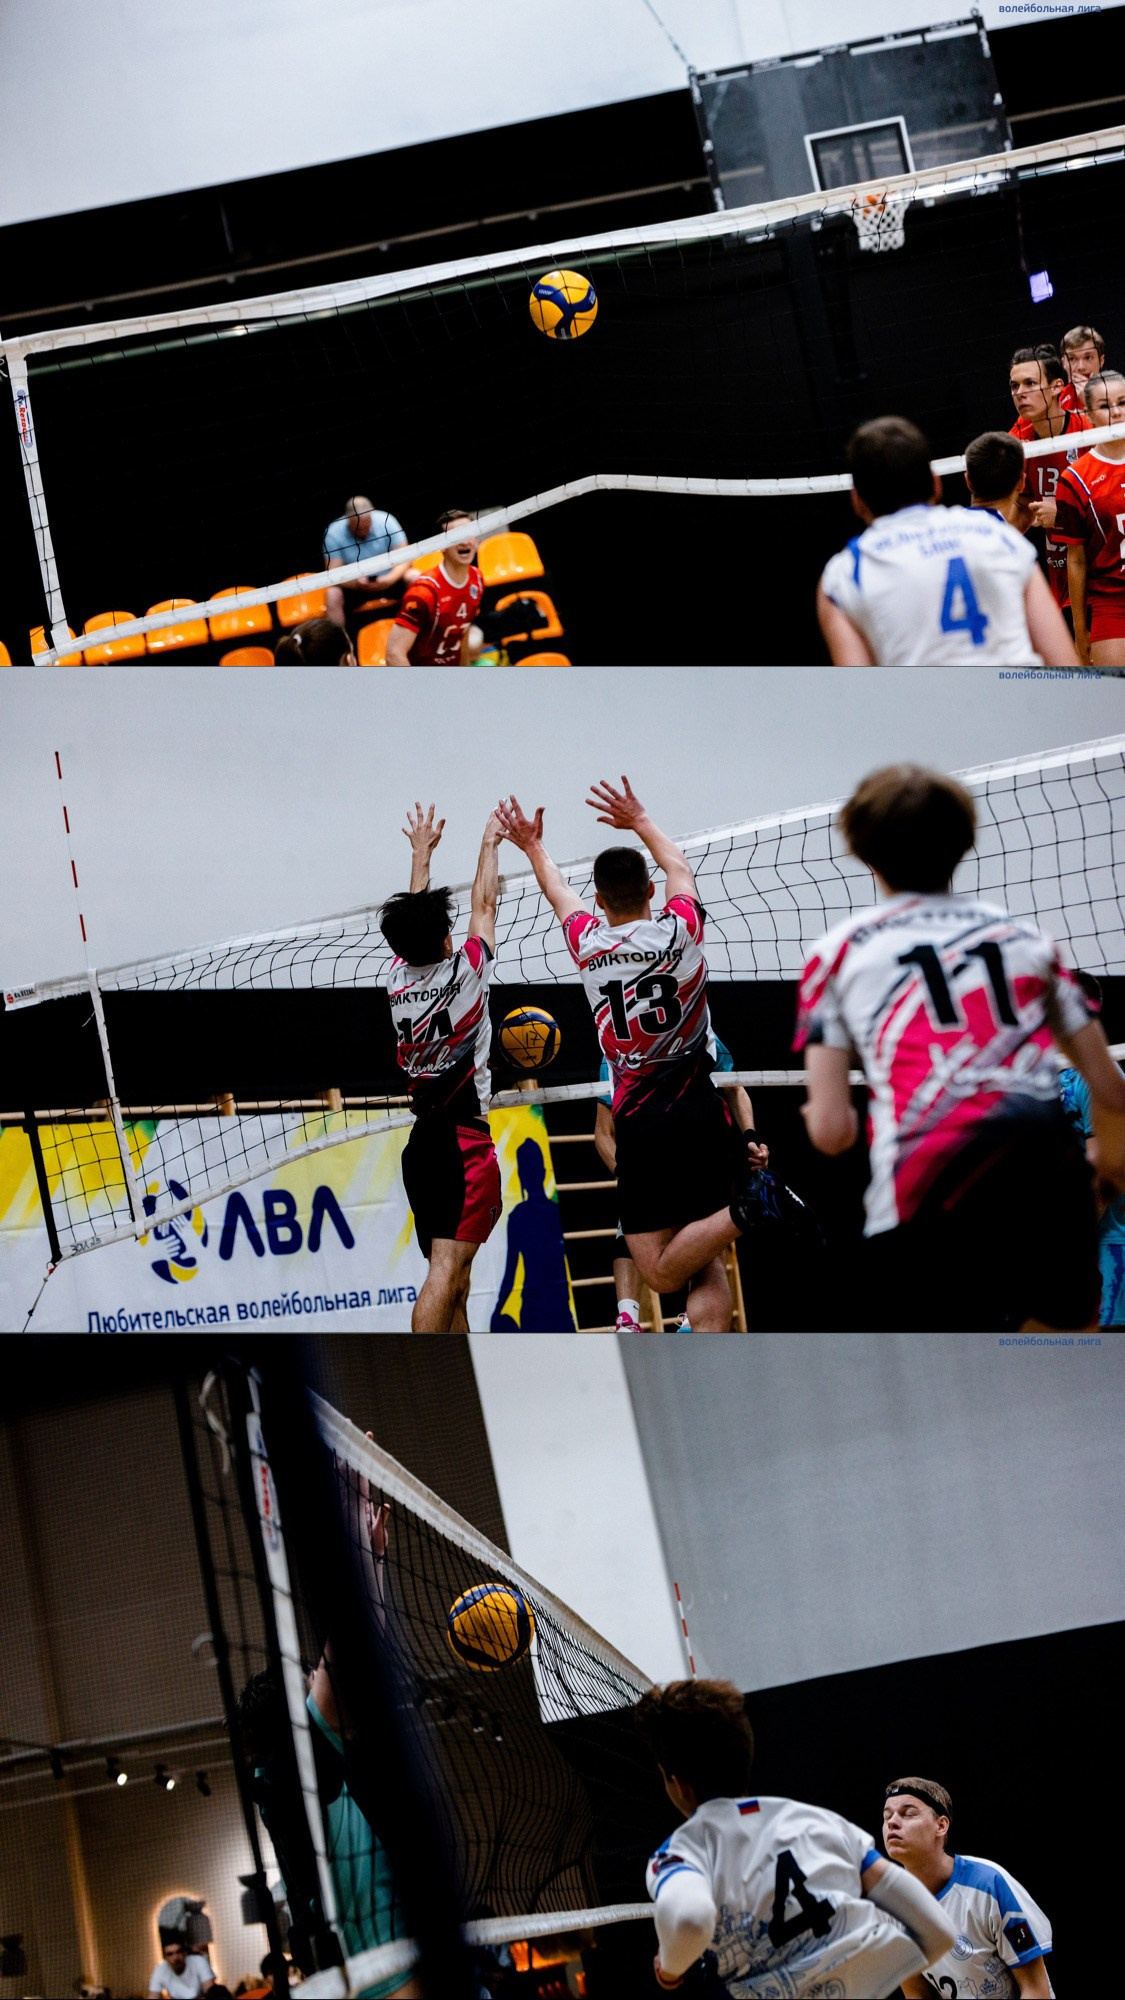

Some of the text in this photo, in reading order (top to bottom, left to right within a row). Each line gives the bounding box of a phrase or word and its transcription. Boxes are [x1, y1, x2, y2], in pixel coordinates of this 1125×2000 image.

[1037, 467, 1060, 497] 13
[455, 602, 468, 619] 4
[940, 556, 989, 646] 4
[588, 948, 684, 972] ВИКТОРИЯ
[897, 941, 1020, 1027] 11
[390, 982, 462, 1008] ВИКТОРИЯ
[598, 973, 683, 1041] 13
[87, 1285, 417, 1333] Любительская волейбольная лига
[768, 1849, 836, 1949] 4
